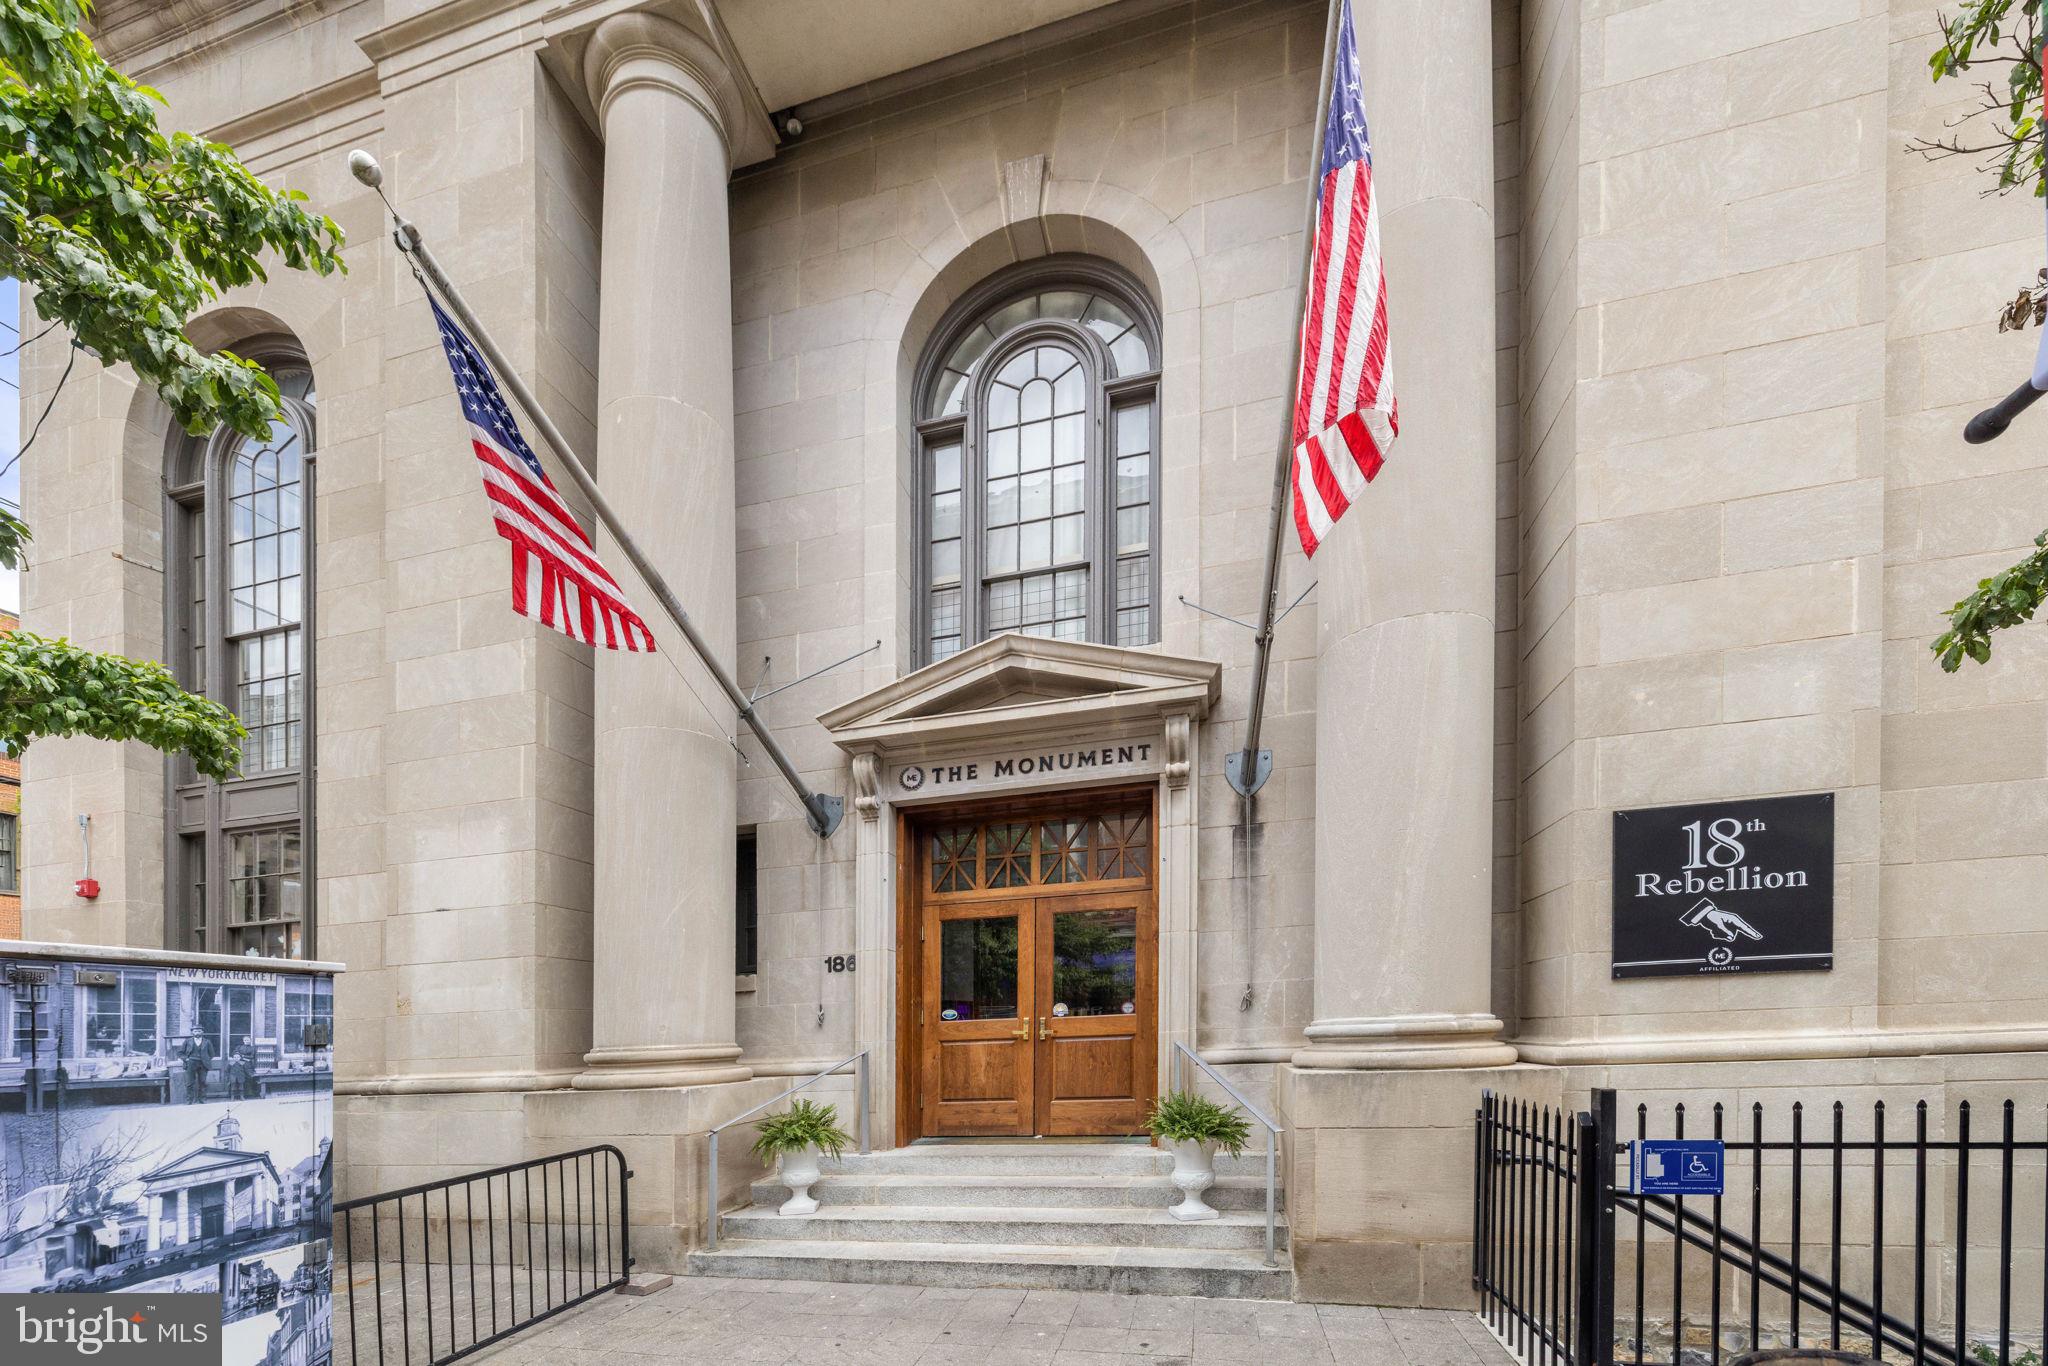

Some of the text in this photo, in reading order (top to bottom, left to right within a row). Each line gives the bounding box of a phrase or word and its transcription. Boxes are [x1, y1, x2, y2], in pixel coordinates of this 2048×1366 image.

[932, 744, 1151, 784] THE MONUMENT
[1635, 867, 1808, 897] Rebellion
[168, 967, 198, 978] NEW
